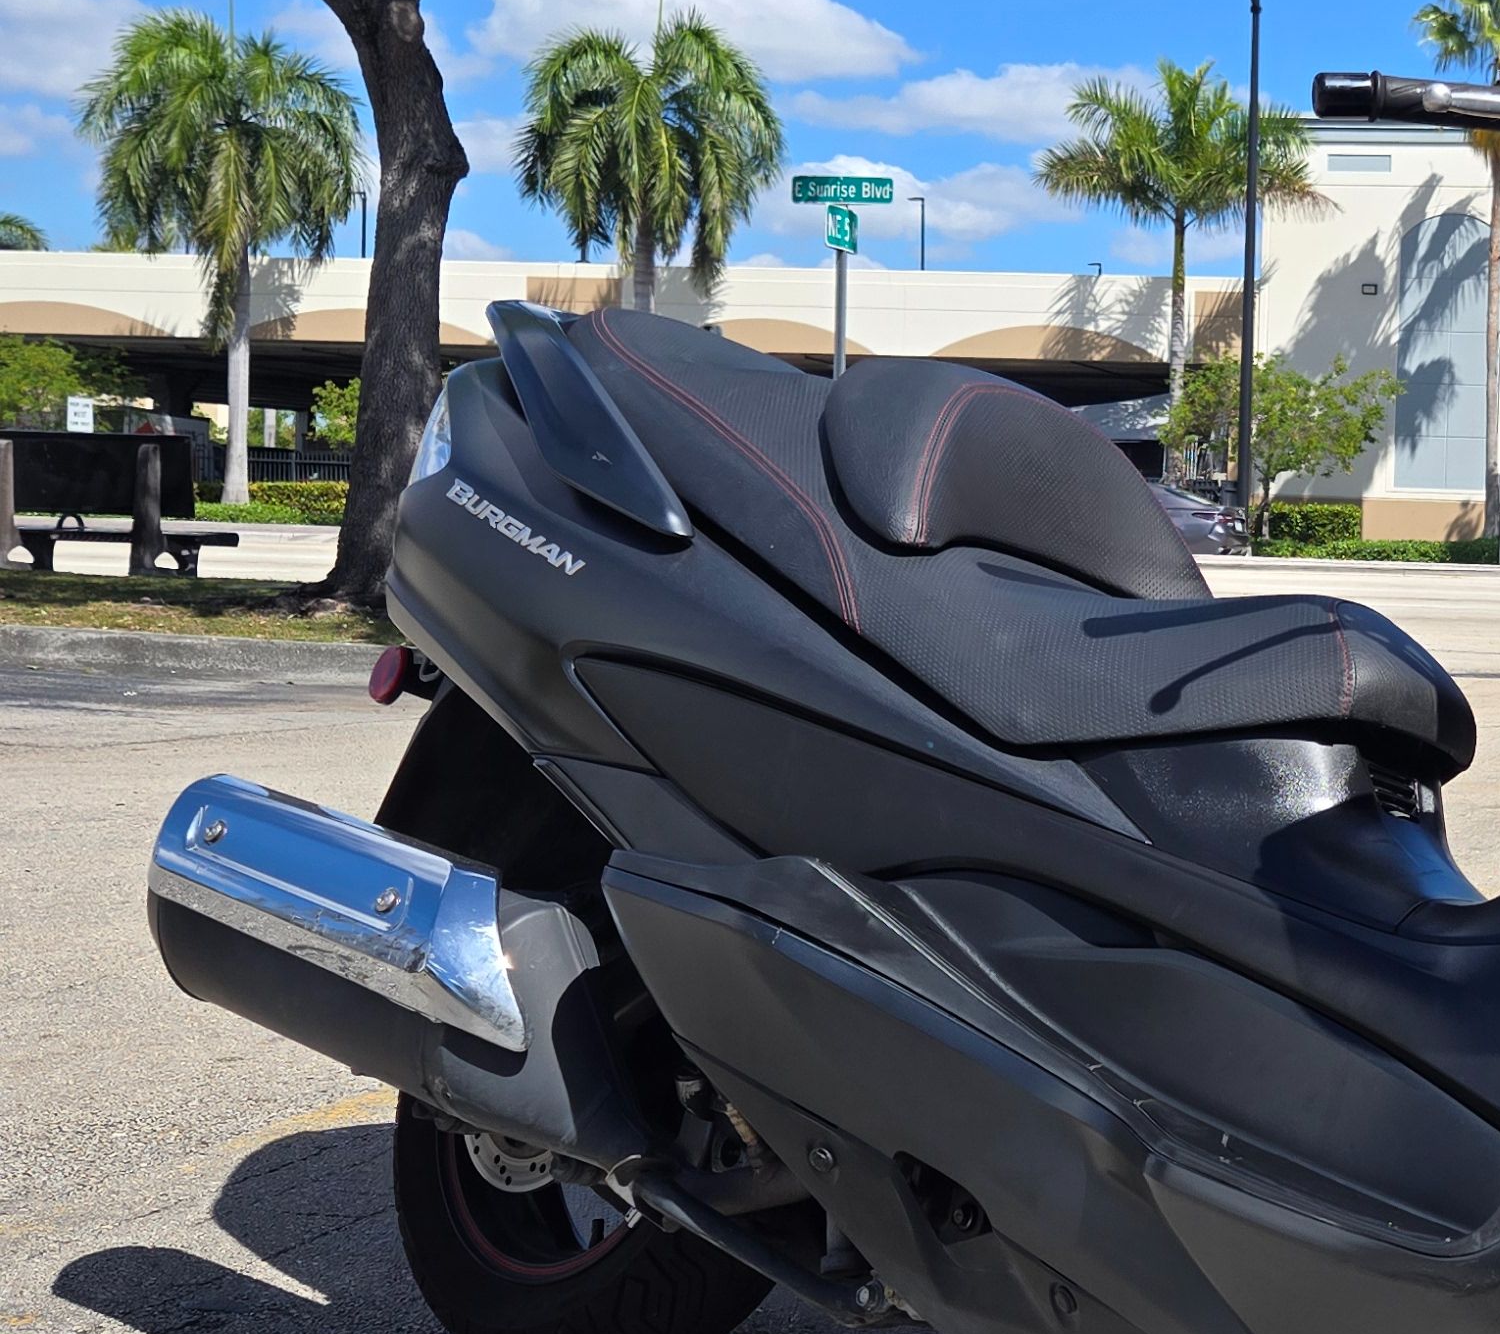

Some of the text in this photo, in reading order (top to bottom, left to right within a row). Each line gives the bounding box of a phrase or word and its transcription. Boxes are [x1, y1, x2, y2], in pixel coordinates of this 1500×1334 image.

[795, 181, 890, 199] E Sunrise Blvd
[828, 213, 842, 240] NE
[446, 478, 586, 576] BURGMAN
